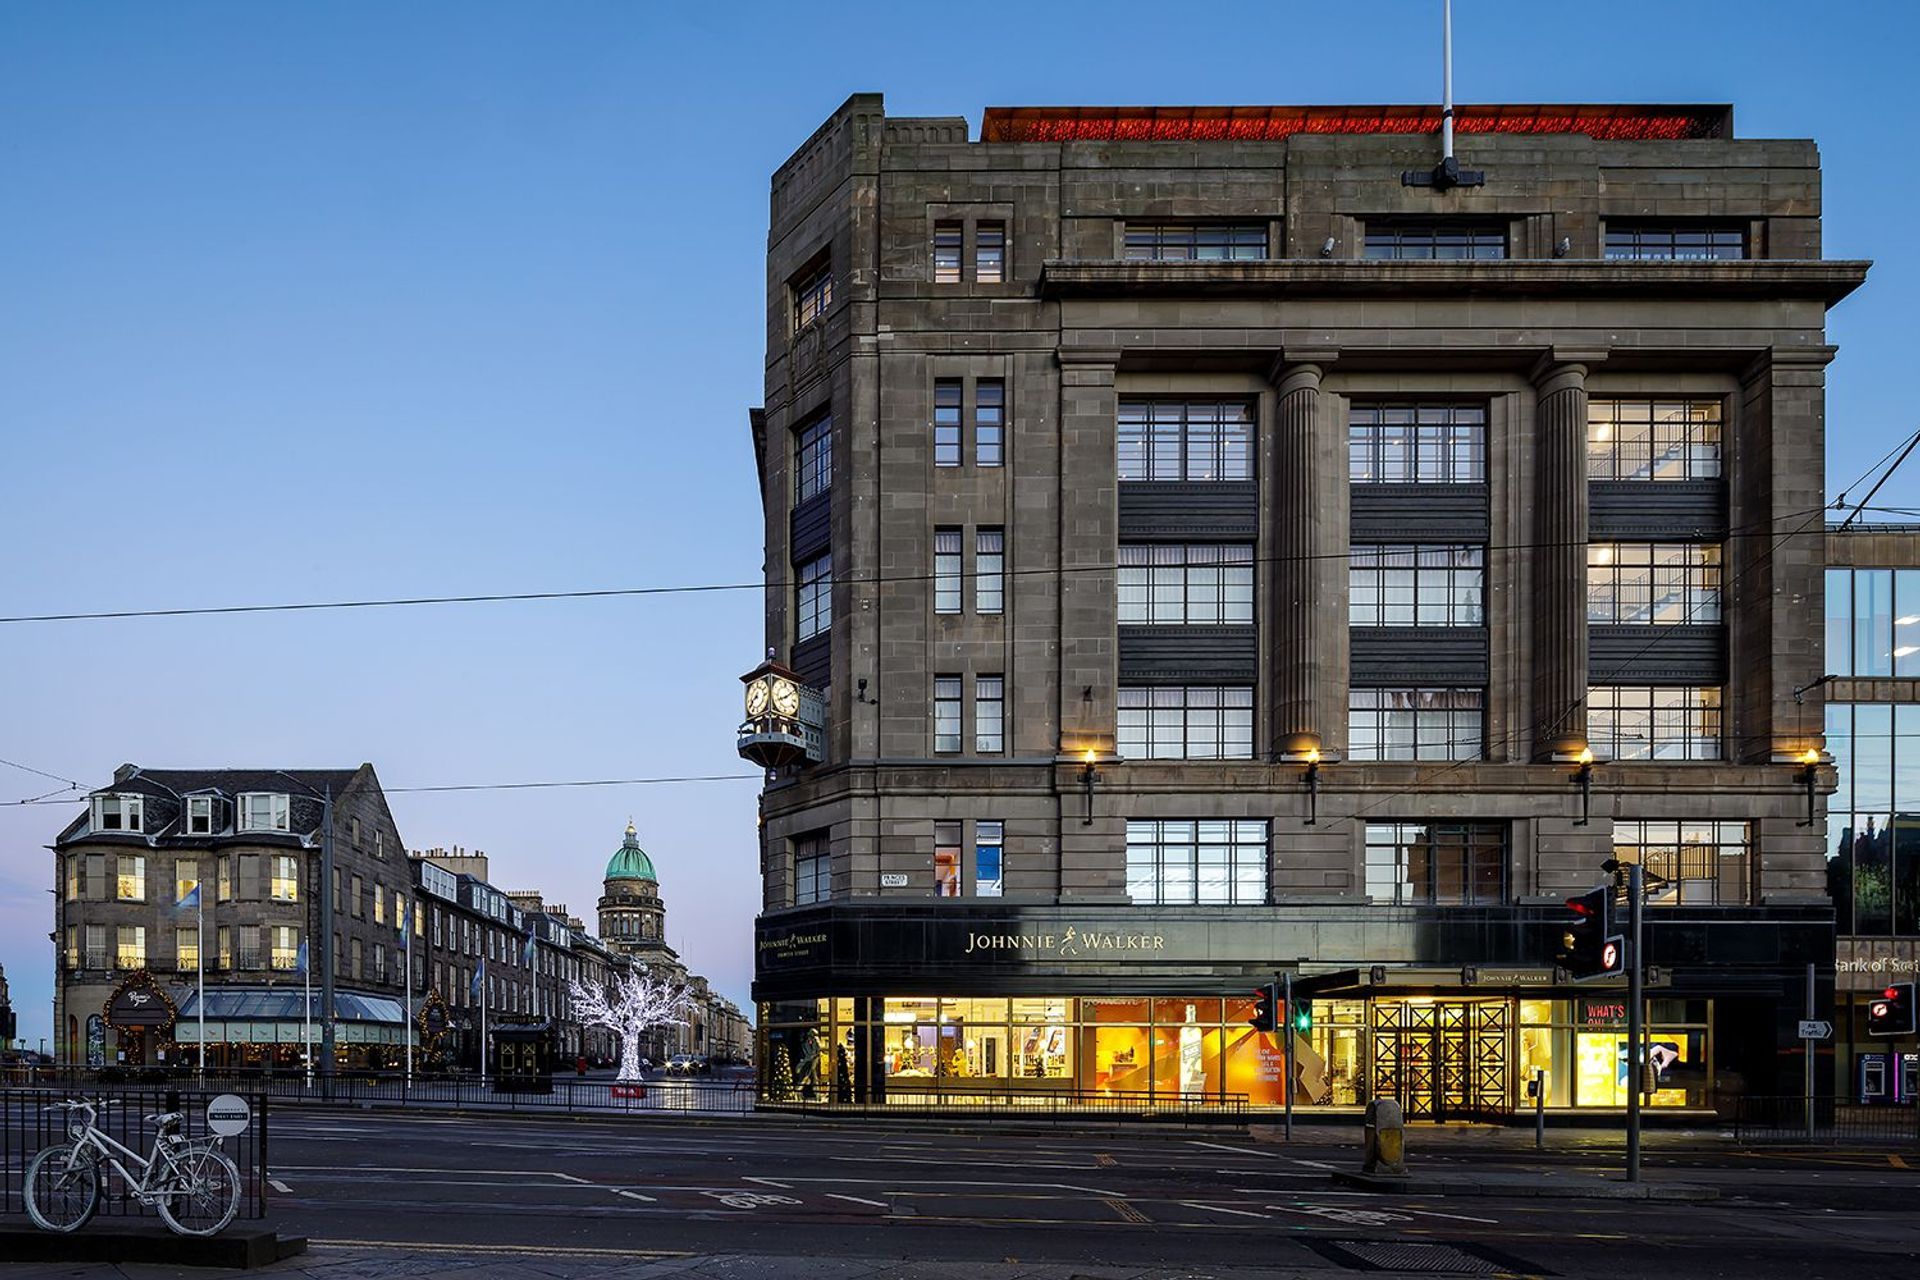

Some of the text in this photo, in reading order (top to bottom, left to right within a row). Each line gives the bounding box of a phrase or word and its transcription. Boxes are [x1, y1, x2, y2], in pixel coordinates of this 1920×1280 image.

[759, 934, 827, 952] JOHNNIE WALKER
[965, 933, 1164, 953] JOHNNIE WALKER
[1871, 957, 1888, 972] of
[1587, 1004, 1625, 1018] WHAT'S
